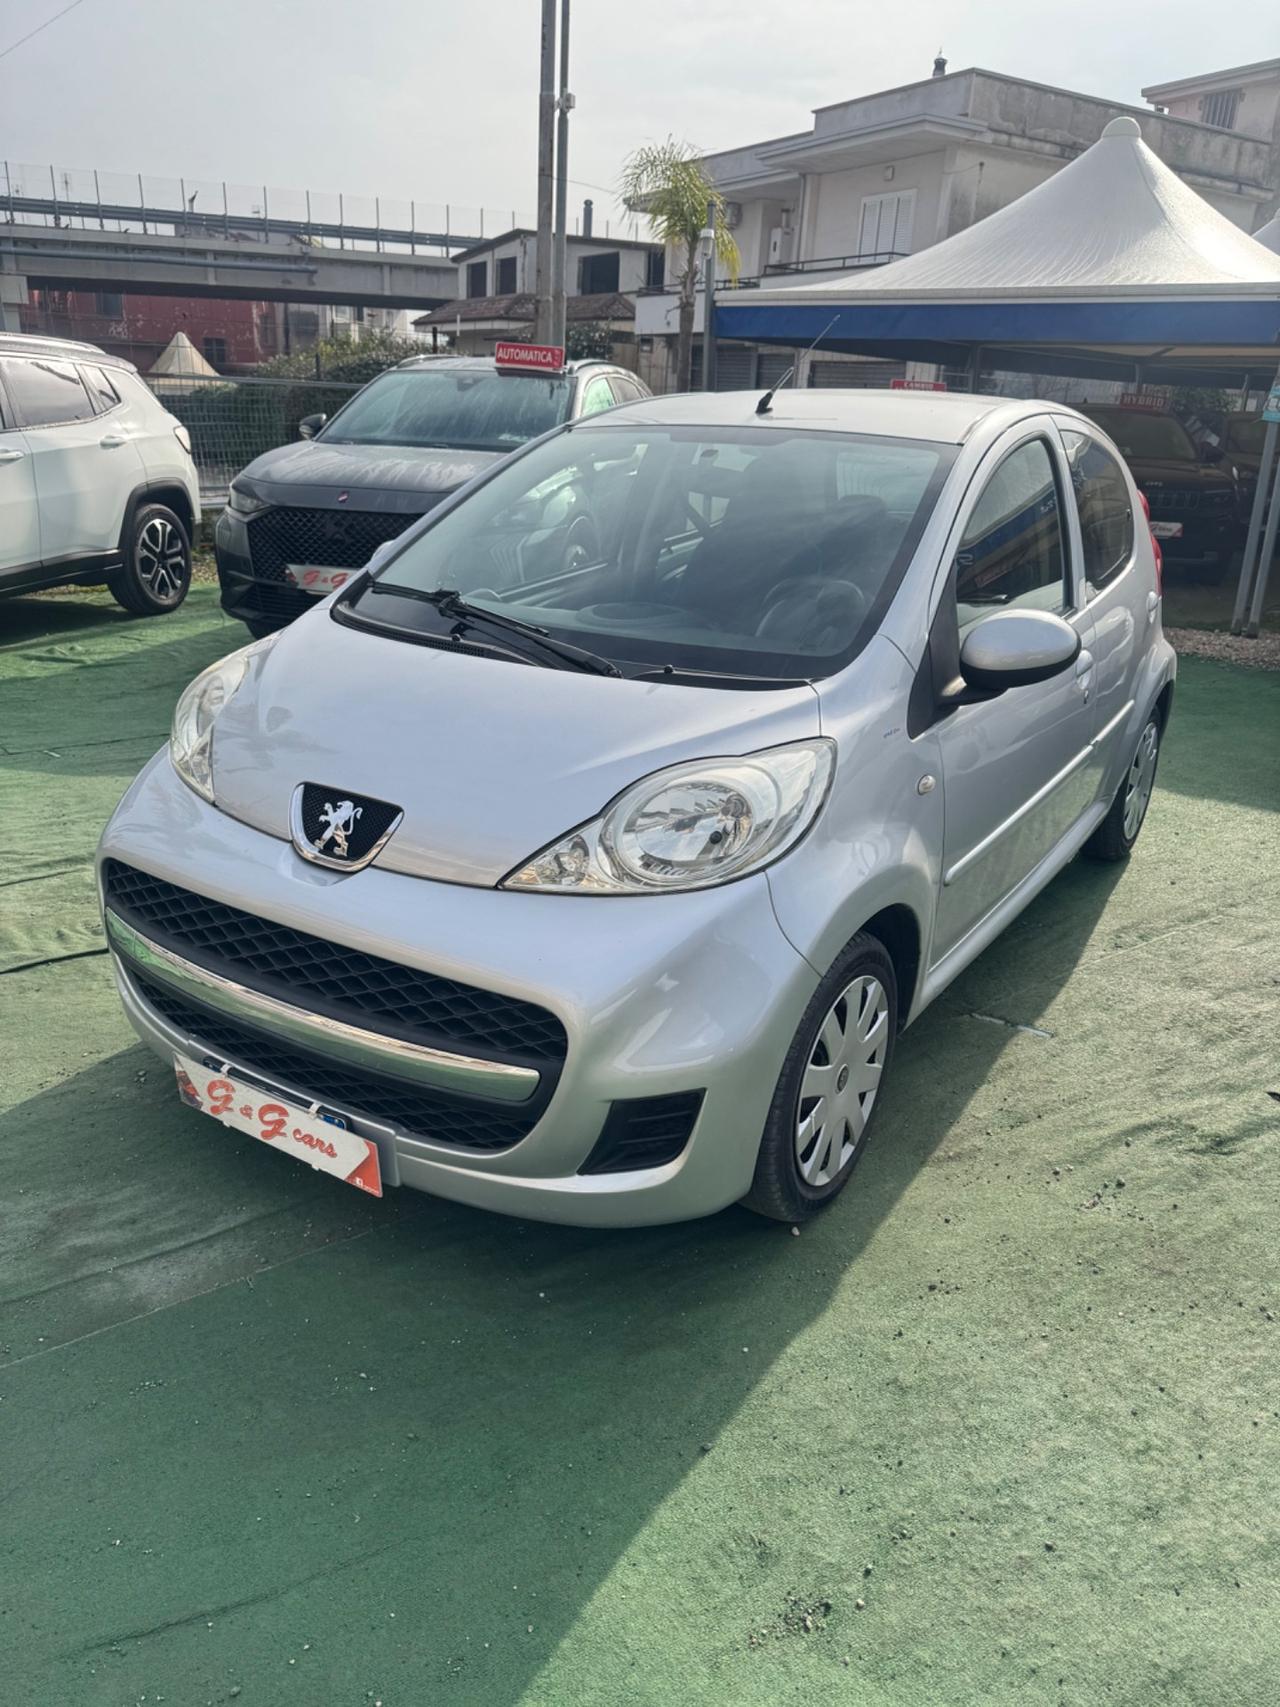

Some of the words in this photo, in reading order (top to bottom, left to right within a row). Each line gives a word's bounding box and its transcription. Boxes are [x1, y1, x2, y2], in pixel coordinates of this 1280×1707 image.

[497, 347, 553, 364] AUTOMATICA
[1123, 394, 1164, 407] HYBRID
[292, 1127, 338, 1158] cars
